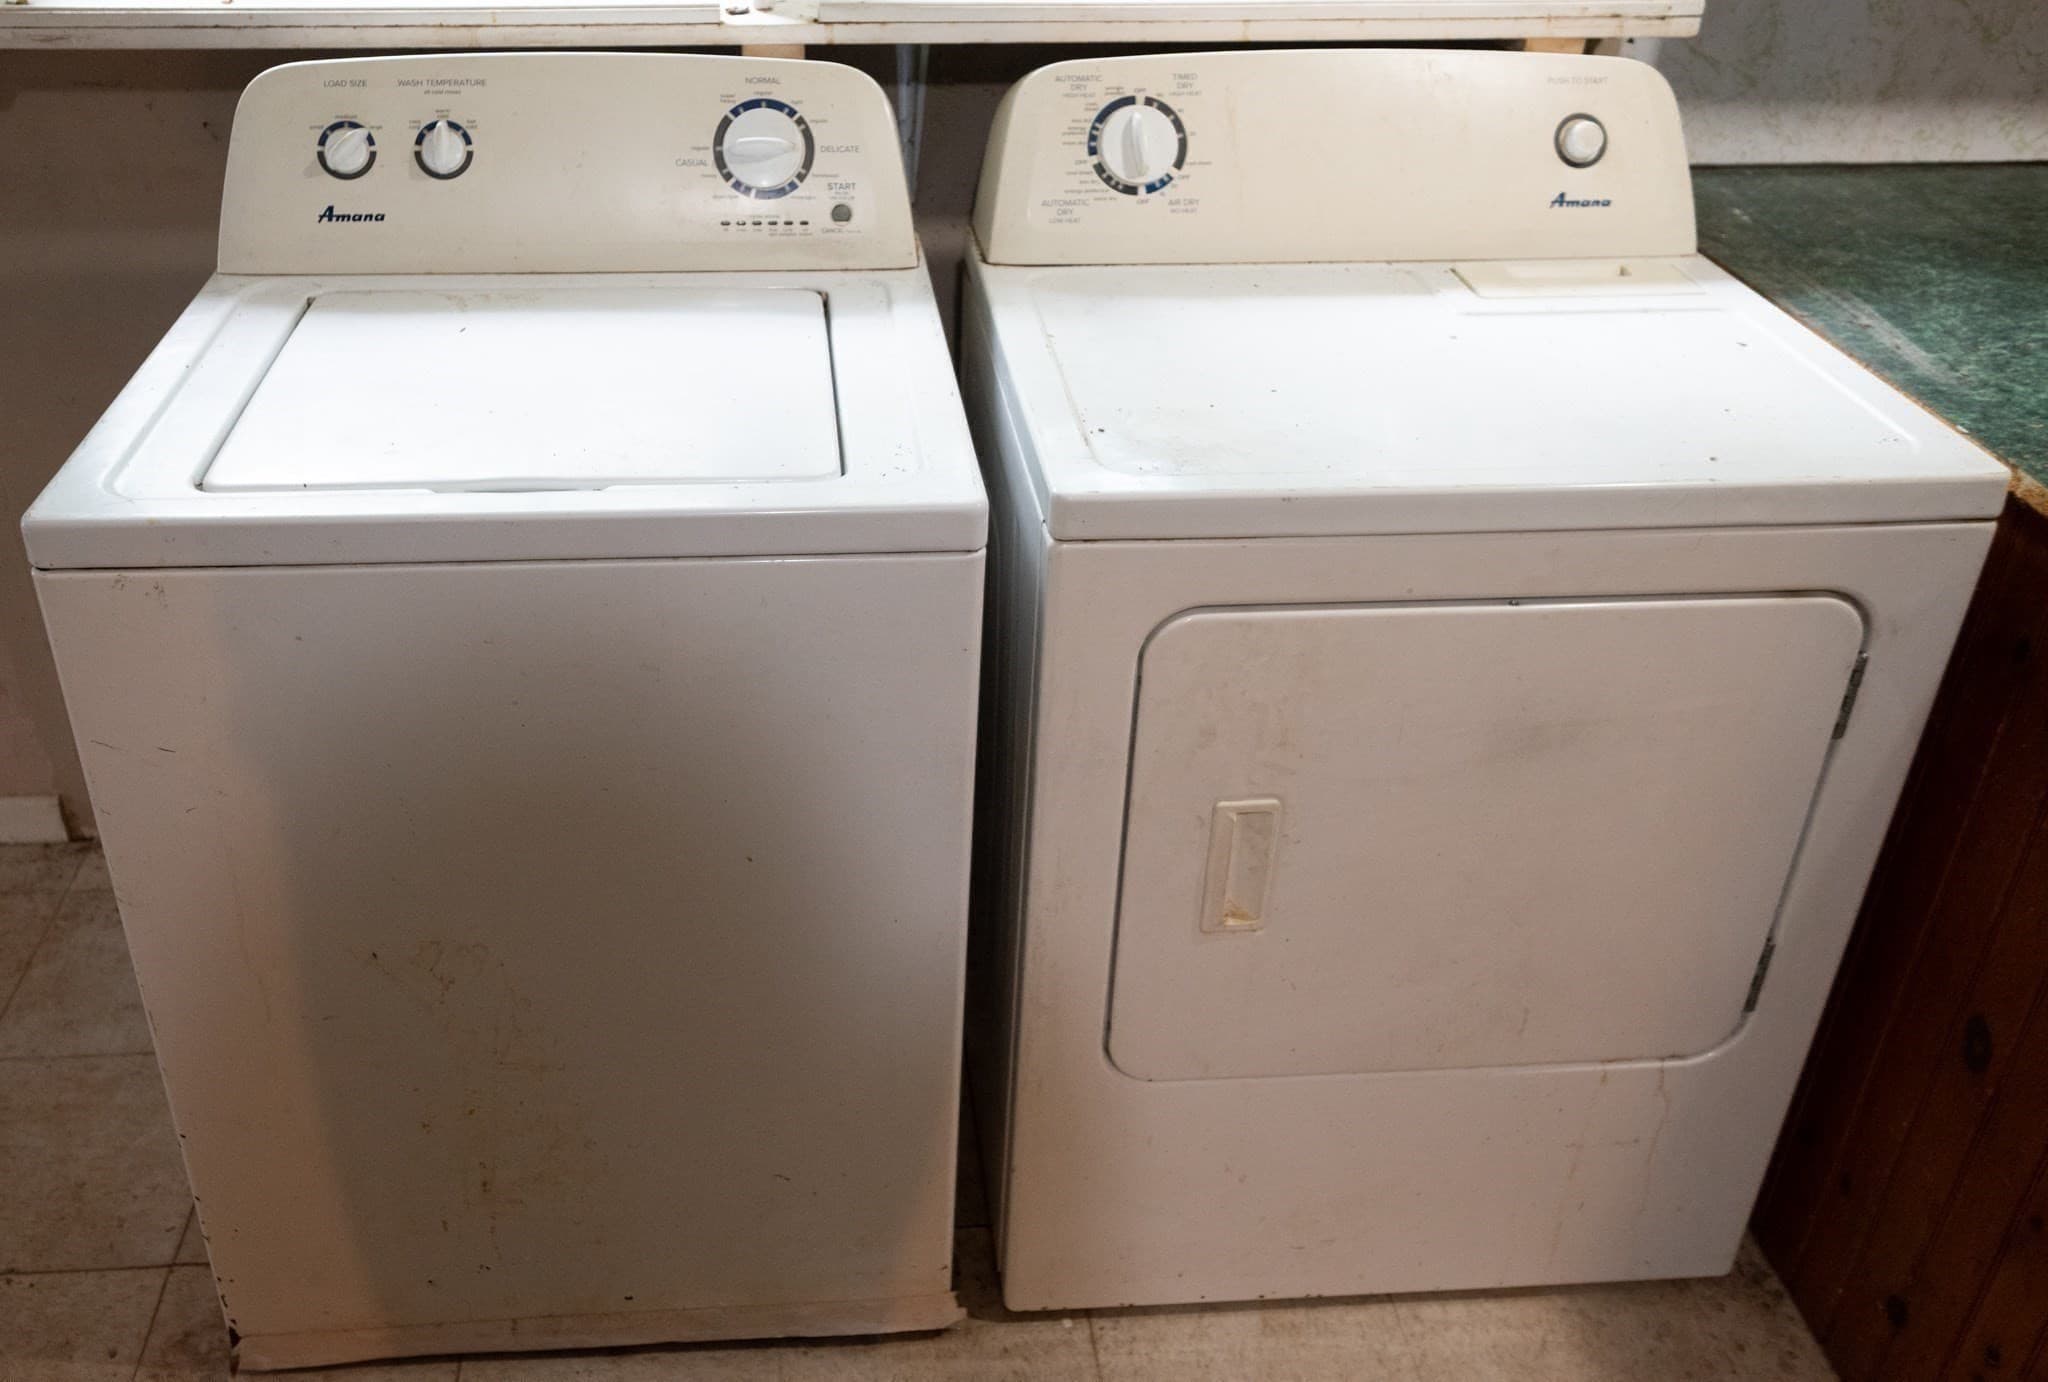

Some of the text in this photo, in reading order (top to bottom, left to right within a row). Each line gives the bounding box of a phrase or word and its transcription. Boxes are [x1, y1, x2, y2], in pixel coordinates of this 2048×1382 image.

[745, 77, 780, 85] NORMAL
[1055, 74, 1103, 82] AUTOMATIC
[323, 79, 368, 88] LOAD SIZE
[397, 78, 487, 88] WASH TEMPERATURE
[1070, 83, 1087, 91] DRY
[1176, 81, 1193, 89] DRY
[820, 145, 860, 153] DELICATE
[675, 158, 707, 167] CASUAL
[827, 182, 856, 190] START
[1041, 199, 1089, 207] AUTOMATIC
[1168, 198, 1200, 206] AIR DRY
[1549, 191, 1612, 208] Amana
[318, 205, 386, 224] Amana
[1056, 208, 1074, 216] DRY
